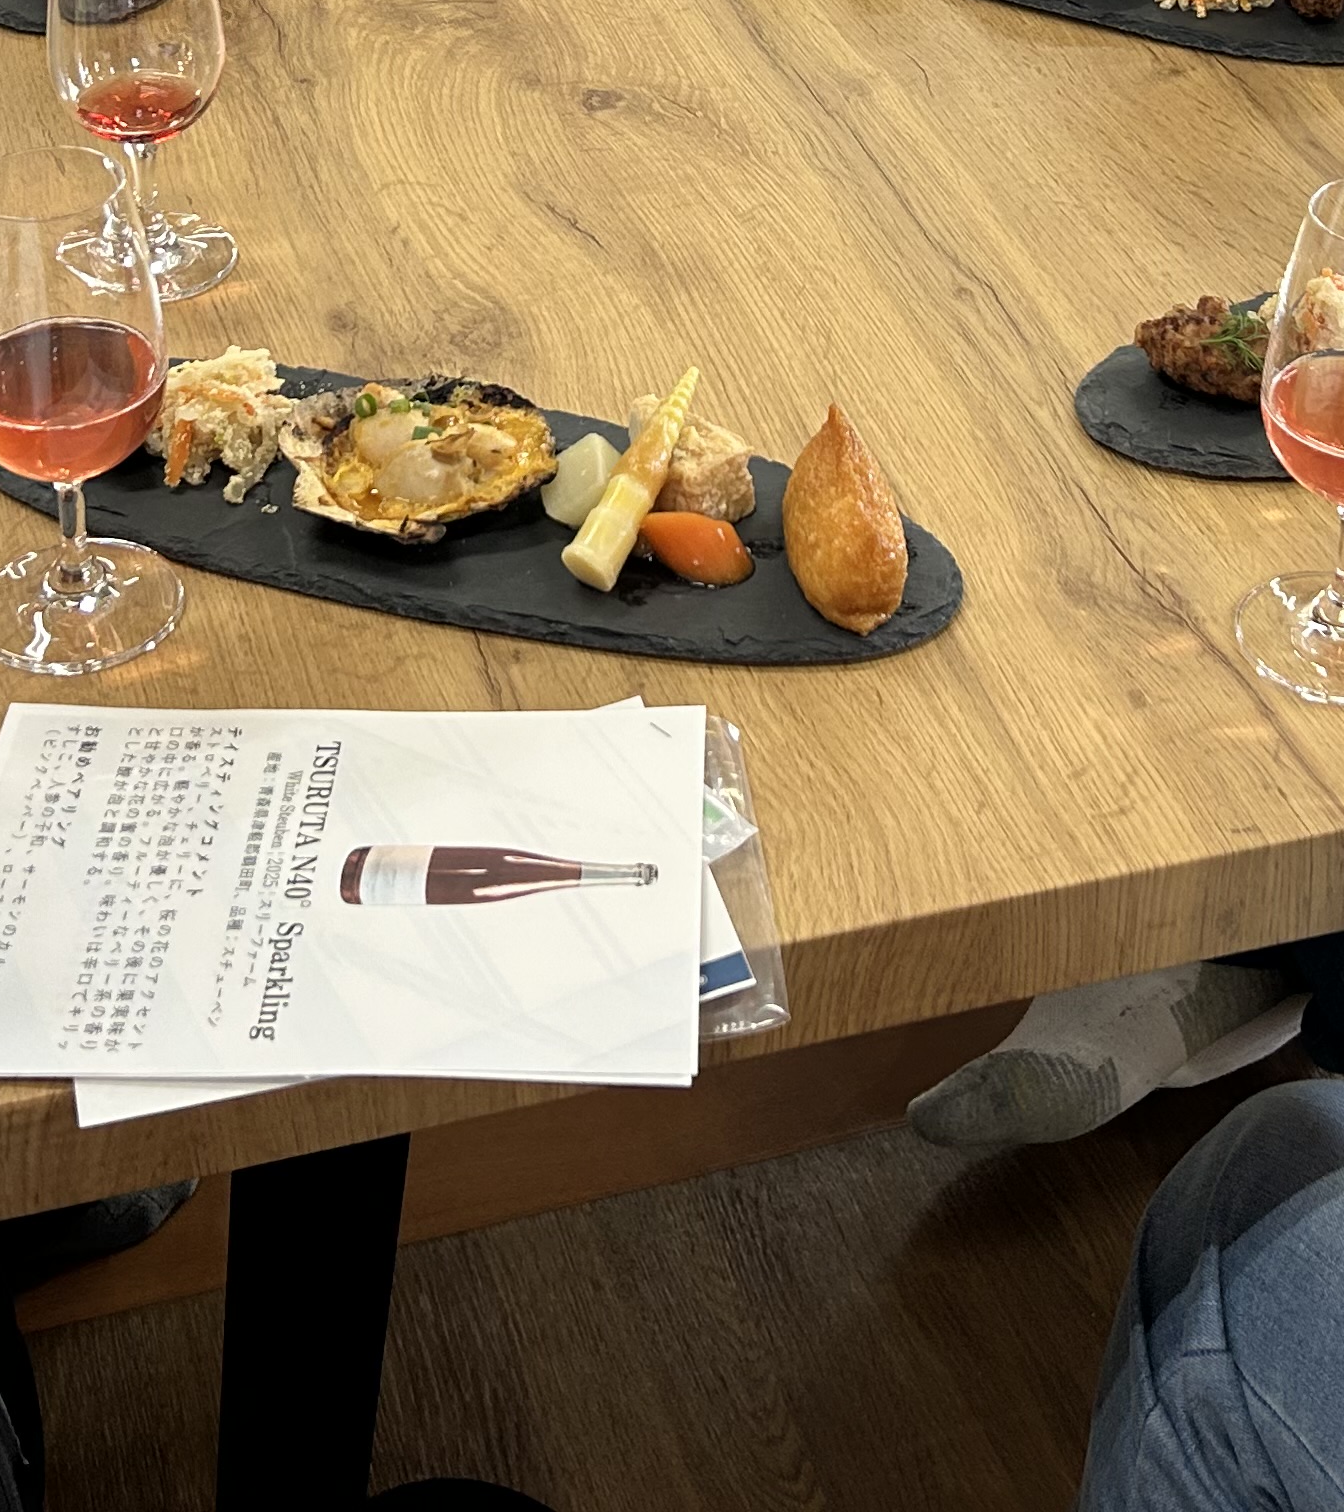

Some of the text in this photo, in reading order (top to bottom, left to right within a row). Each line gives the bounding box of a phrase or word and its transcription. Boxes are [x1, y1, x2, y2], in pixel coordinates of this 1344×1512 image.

[280, 770, 304, 802] White
[293, 741, 343, 848] TSURUTA
[269, 804, 296, 848] Steuben
[261, 857, 285, 888] 2025
[238, 899, 276, 987] スリーファーム
[247, 921, 306, 1041] Sparkling
